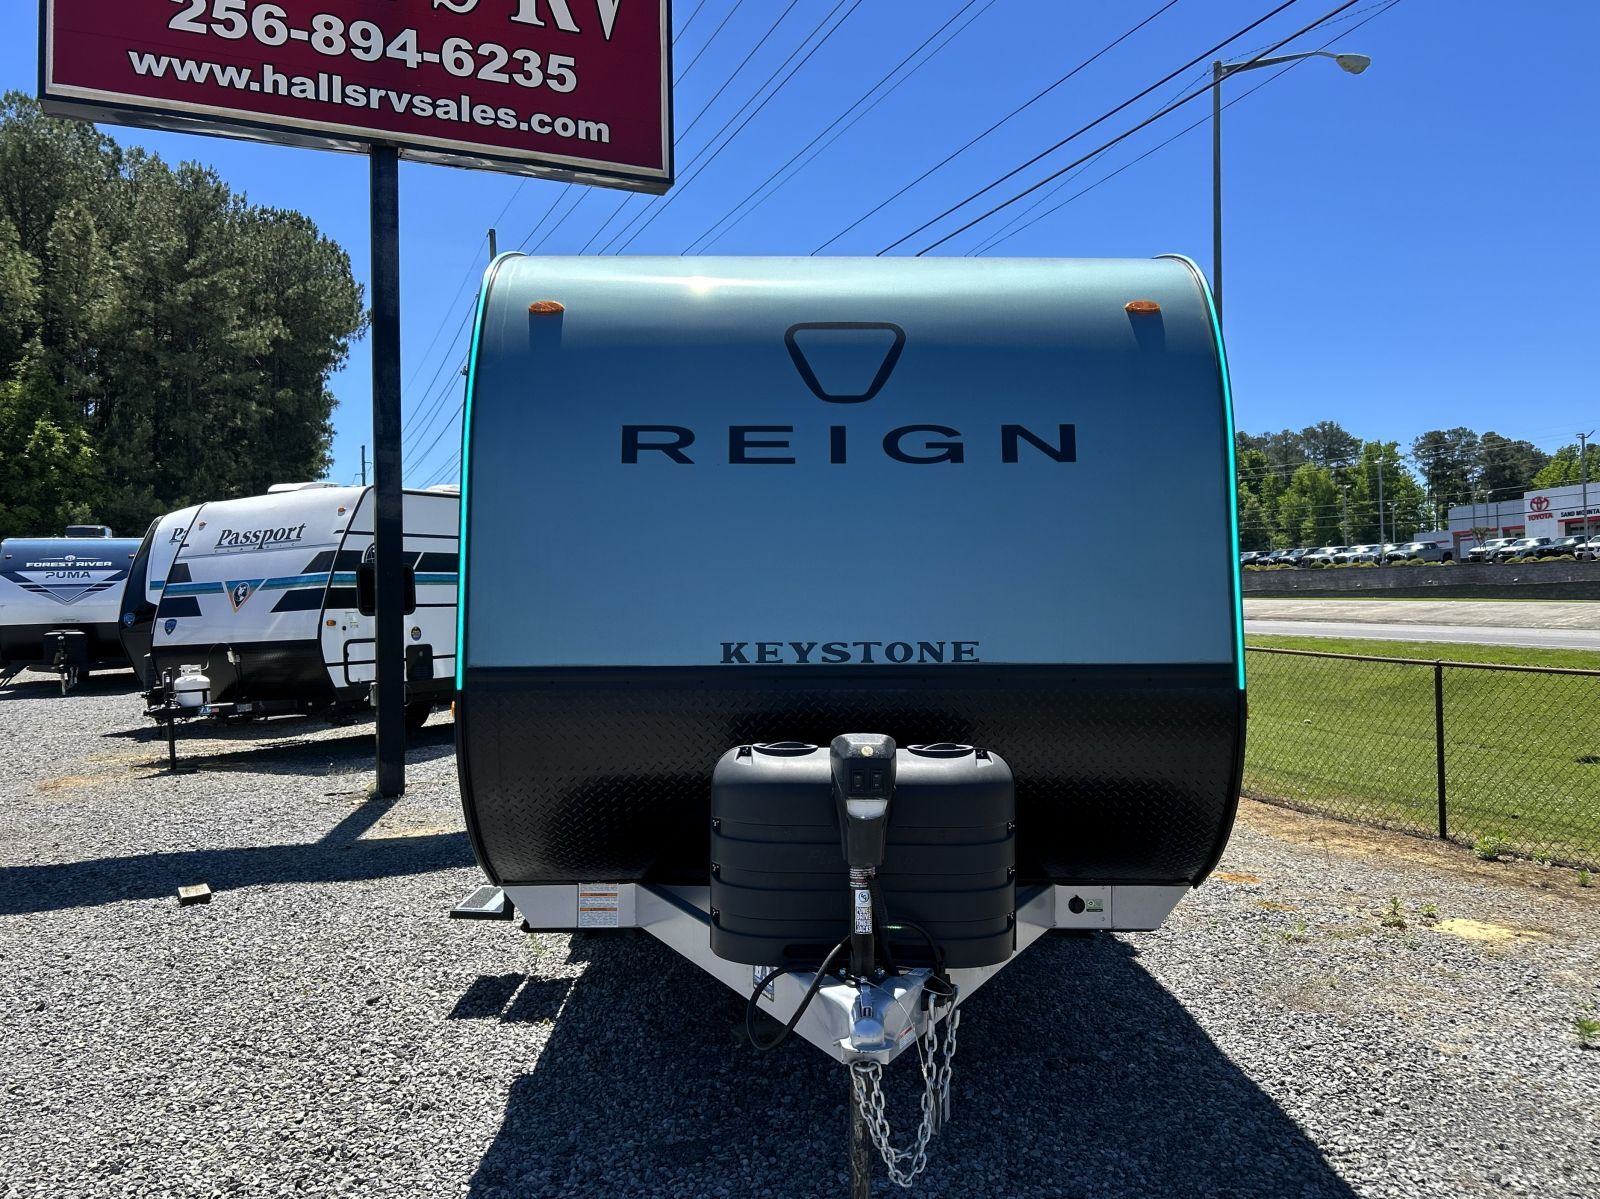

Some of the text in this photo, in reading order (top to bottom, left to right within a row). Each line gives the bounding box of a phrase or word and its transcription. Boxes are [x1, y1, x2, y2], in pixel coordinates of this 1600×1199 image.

[168, 0, 578, 94] 256-894-6235
[127, 50, 611, 143] www.hallsrvsales.com
[621, 424, 1077, 465] REIGN
[1528, 512, 1554, 521] TOYOTA
[215, 522, 307, 550] Passport
[45, 571, 91, 579] PUMA
[719, 641, 980, 664] KEYSTONE
